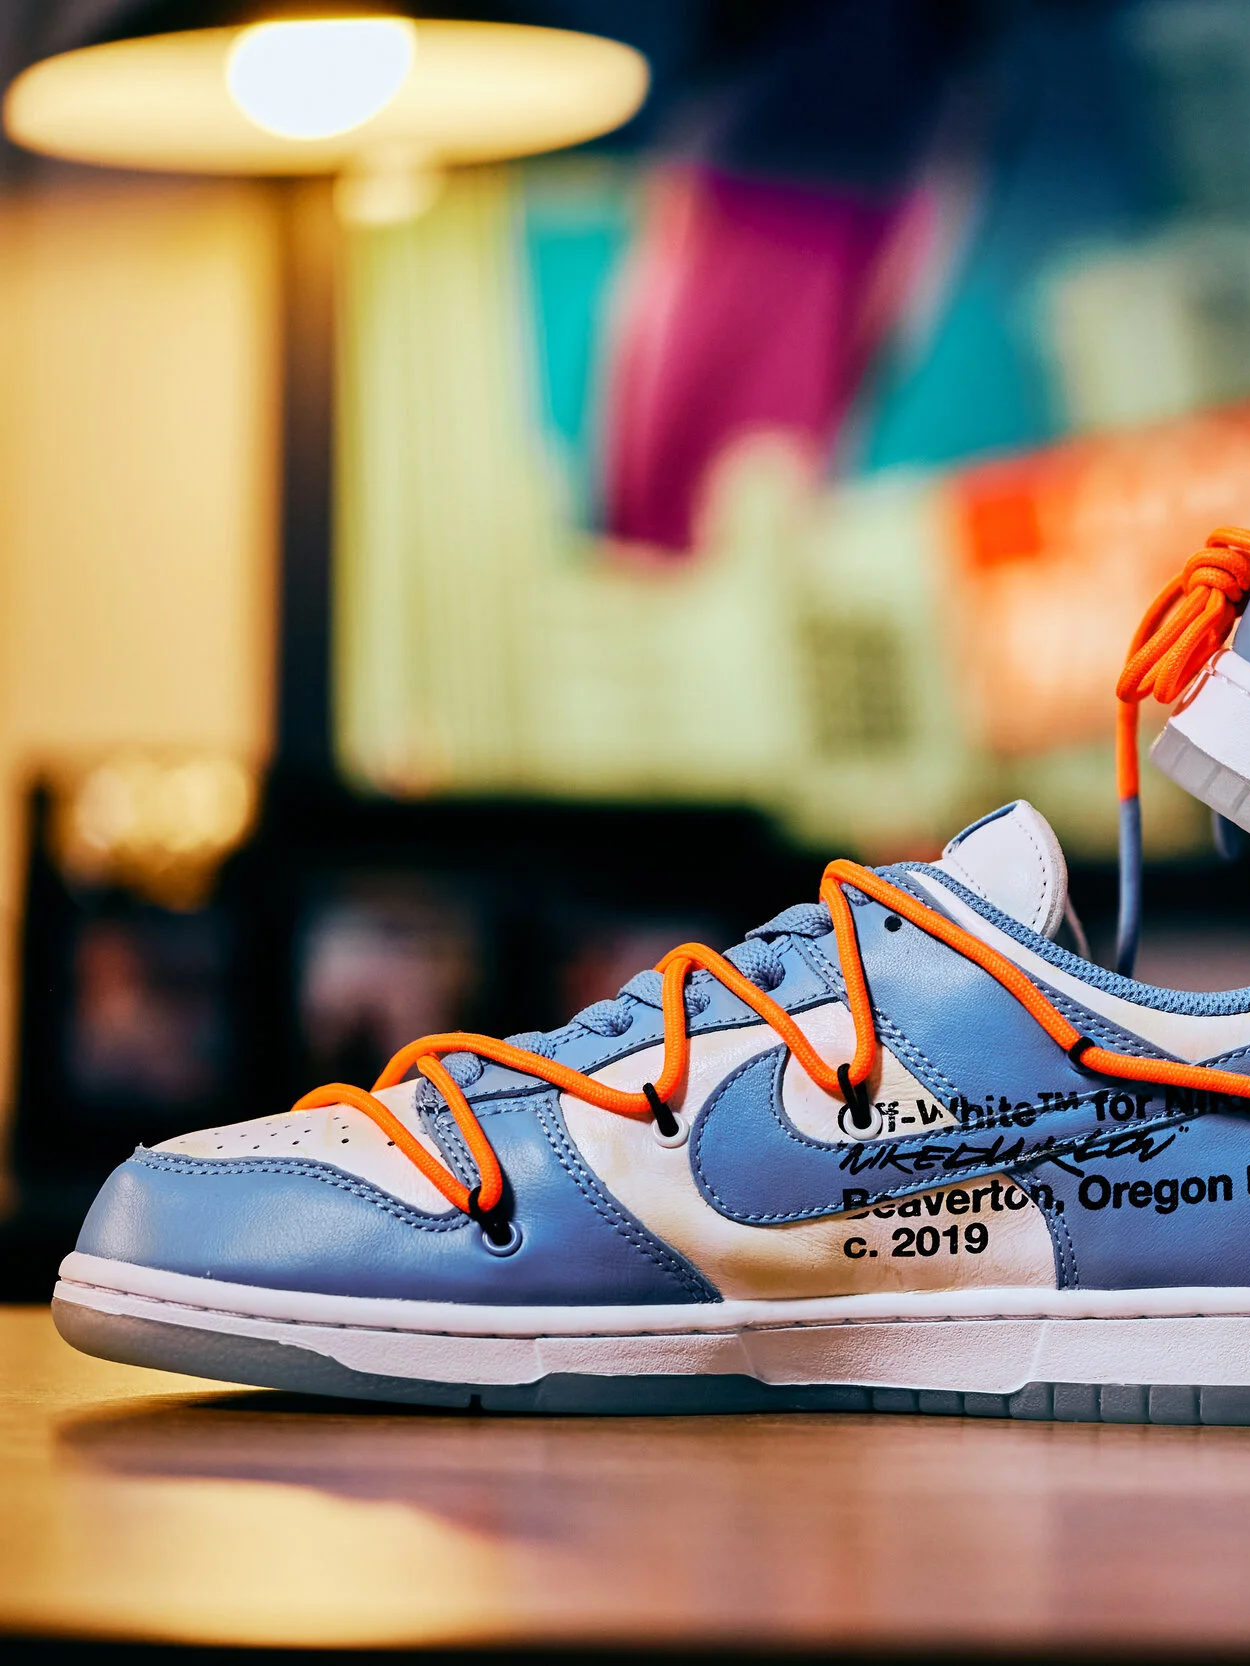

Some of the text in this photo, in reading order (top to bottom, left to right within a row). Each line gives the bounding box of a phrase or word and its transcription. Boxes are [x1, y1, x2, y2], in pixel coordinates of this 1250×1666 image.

[1092, 1090, 1153, 1122] for
[842, 1179, 1064, 1219] Beaverton,
[1078, 1173, 1232, 1214] Oregon
[843, 1222, 989, 1259] c. 2019
